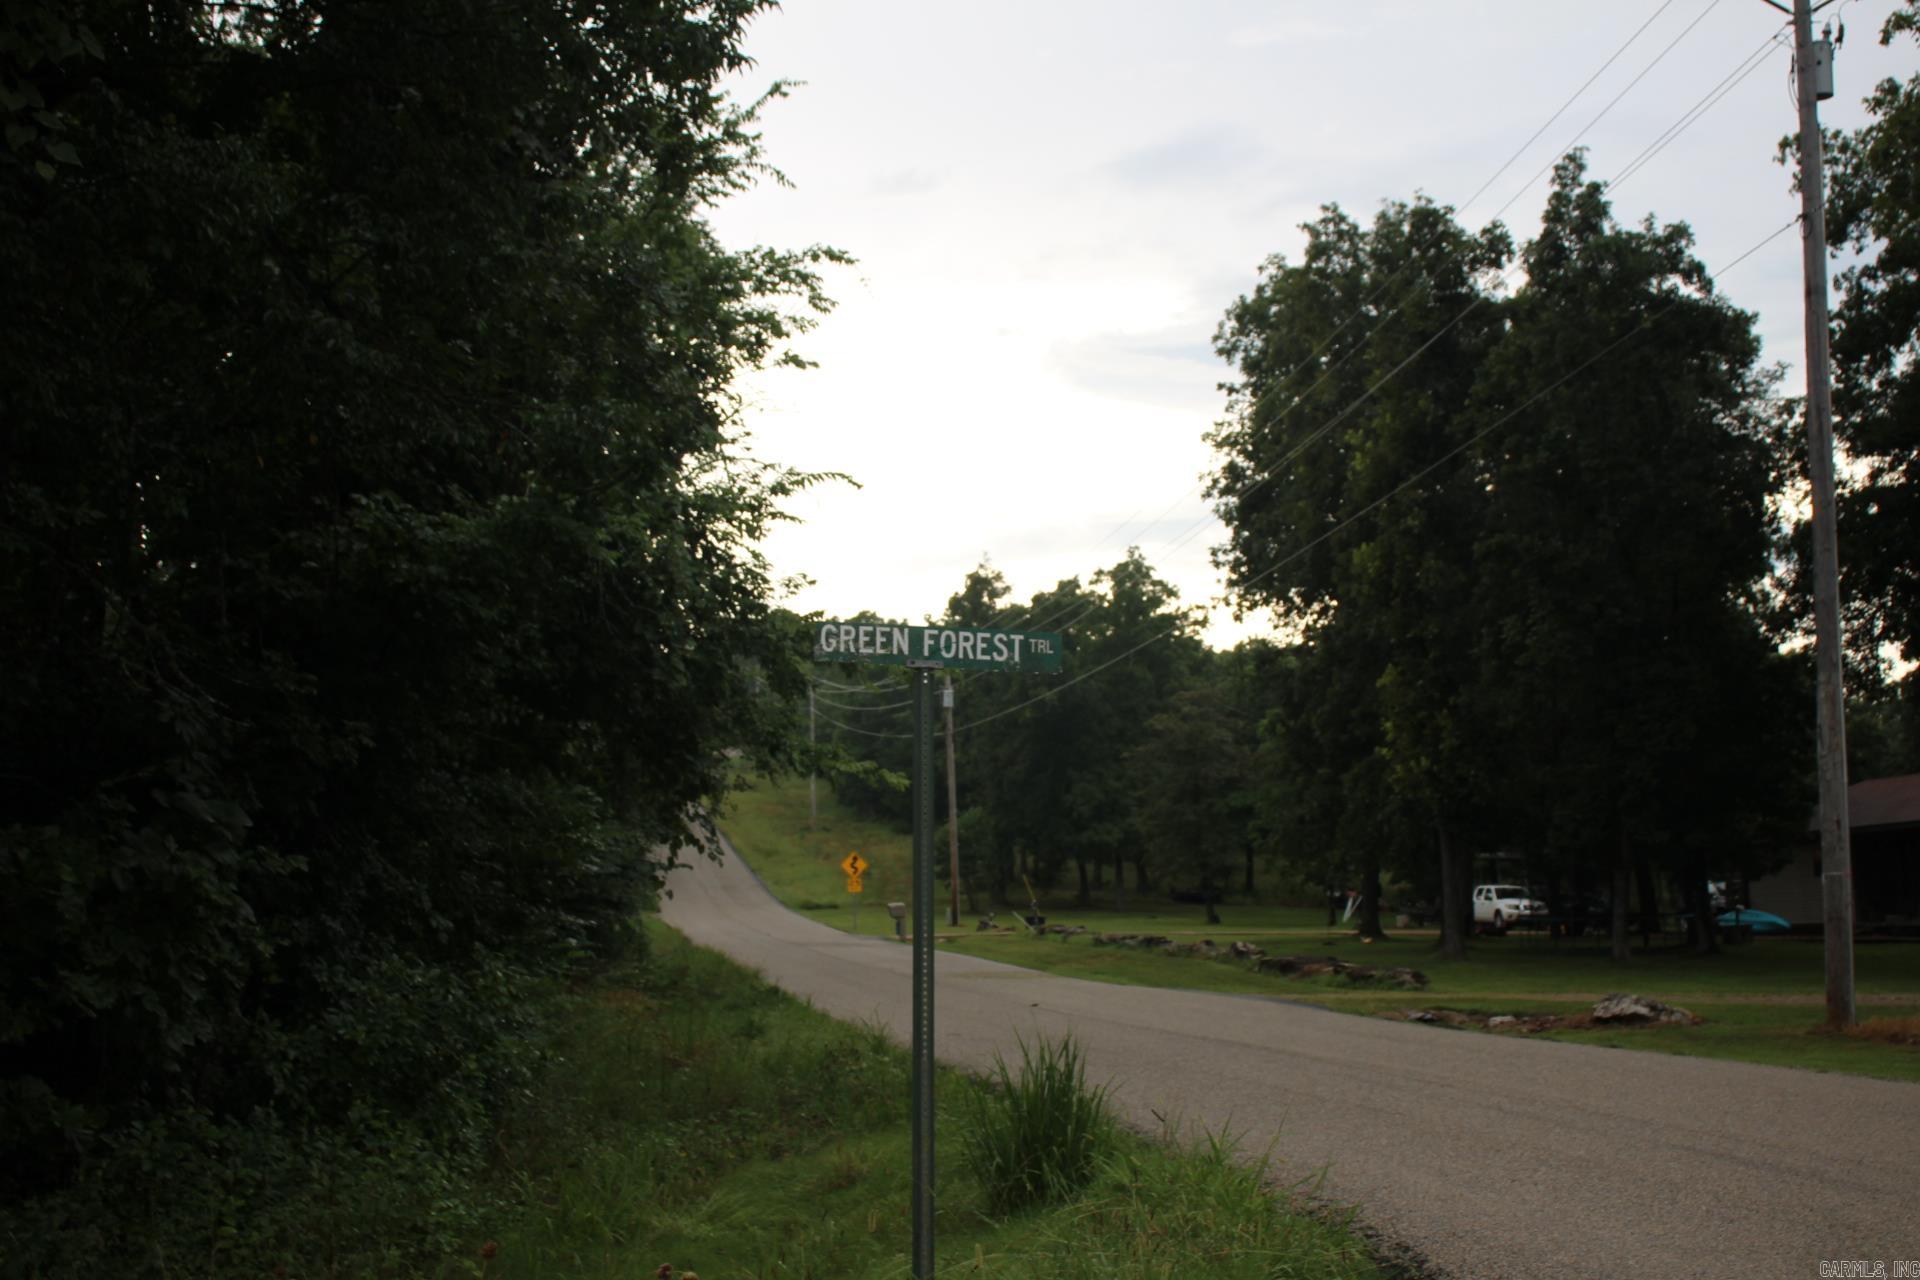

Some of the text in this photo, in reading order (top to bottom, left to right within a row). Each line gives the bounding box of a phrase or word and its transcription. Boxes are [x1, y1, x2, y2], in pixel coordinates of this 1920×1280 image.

[820, 624, 1054, 662] GREEN FOREST TRL
